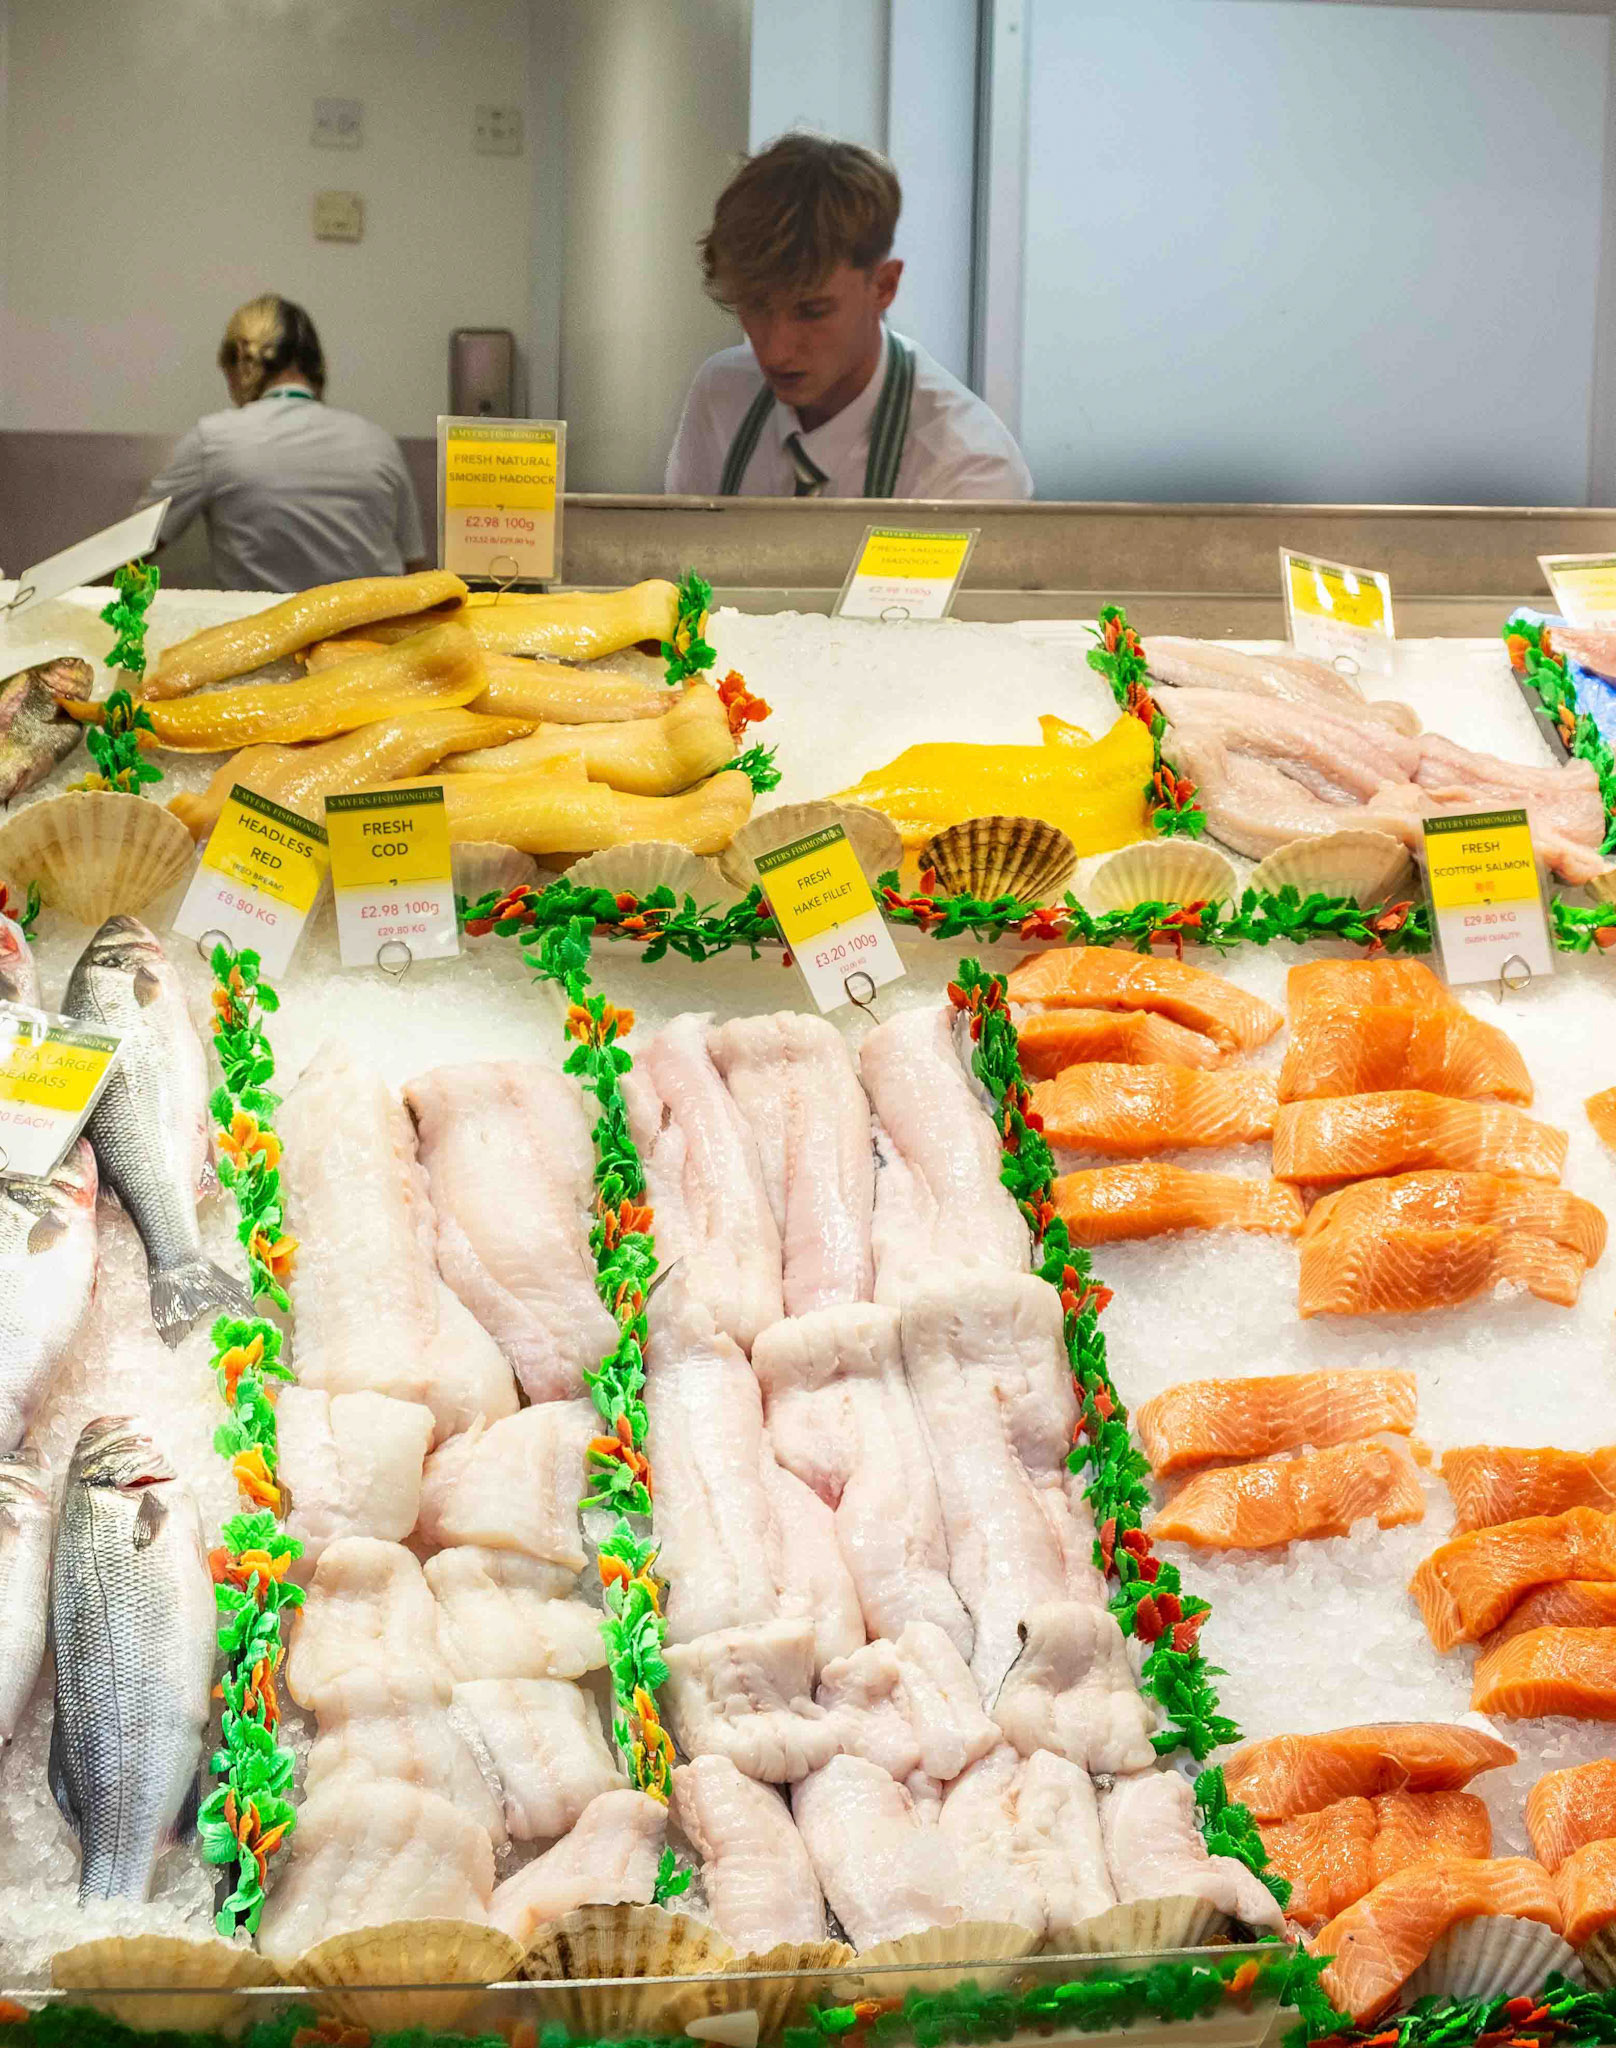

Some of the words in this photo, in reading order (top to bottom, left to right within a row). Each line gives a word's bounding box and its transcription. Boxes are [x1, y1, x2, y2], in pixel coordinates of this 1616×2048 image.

[454, 453, 492, 465] FRESH
[496, 456, 551, 467] NATURAL
[449, 472, 496, 483] SMOKED
[499, 474, 555, 485] HADDOCK
[465, 516, 499, 529] £2.98
[505, 517, 535, 532] 100g
[241, 790, 271, 813] MYERS
[338, 796, 371, 807] MYERS
[372, 790, 441, 805] FISHMONGERS
[362, 819, 414, 836] FRESH
[1465, 814, 1524, 828] FISHMONGERS
[237, 813, 314, 859] HEADLESS
[371, 842, 409, 858] COD
[1461, 841, 1501, 855] FRESH
[250, 846, 283, 870] RED
[759, 861, 766, 870] S
[765, 851, 792, 868] MYERS
[1433, 864, 1483, 878] SCOTTISH
[1485, 859, 1531, 873] SALMON
[796, 867, 833, 891] FRESH
[217, 890, 254, 915] £8.80
[255, 907, 279, 926] KG
[792, 896, 823, 917] HAKE
[823, 881, 854, 905] FILLET
[361, 903, 399, 919] £2.98
[405, 900, 440, 916] 100g
[1500, 911, 1517, 923] KG
[377, 925, 409, 937] £29.80
[411, 923, 427, 934] KG
[815, 944, 847, 969] £3.20
[848, 932, 879, 953] 100g
[46, 1053, 98, 1073] LARGE
[12, 1113, 56, 1131] EACH
